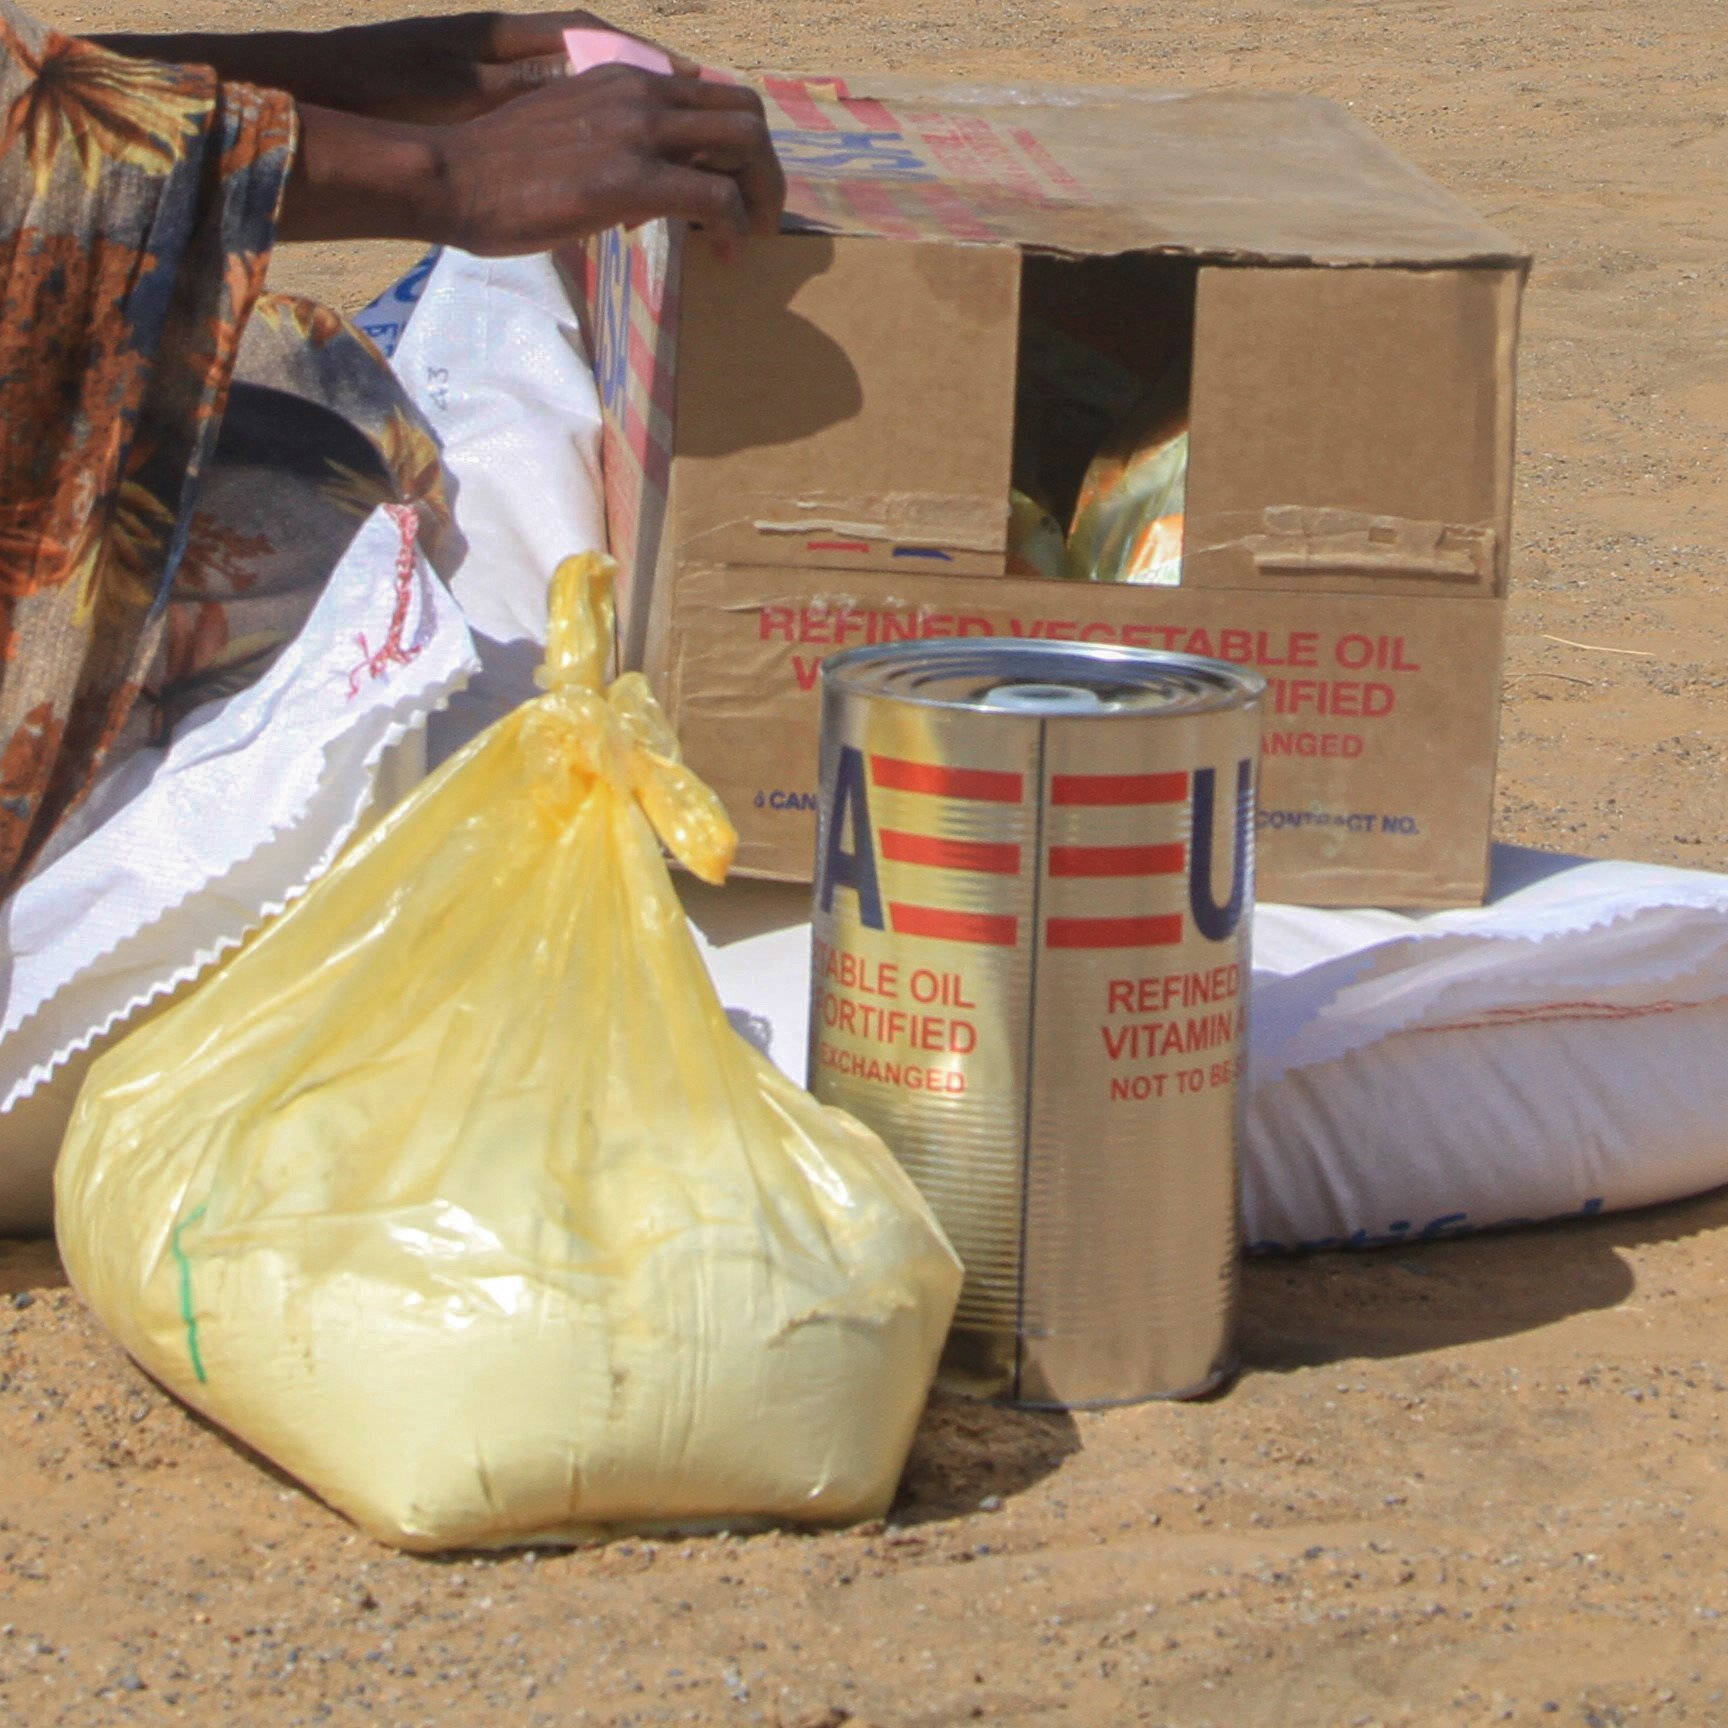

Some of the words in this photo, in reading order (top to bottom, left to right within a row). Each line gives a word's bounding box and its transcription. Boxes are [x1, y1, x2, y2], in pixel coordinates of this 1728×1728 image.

[758, 605, 994, 645] REFINED
[1009, 617, 1319, 668] VEGETABLE
[1334, 633, 1421, 672] OIL
[1267, 678, 1396, 718] IFIED
[1380, 814, 1422, 835] NO.
[815, 938, 899, 1000] TABLE
[910, 968, 977, 1010] OIL
[1107, 963, 1240, 1015] REFINED
[1102, 1014, 1233, 1061] VITAMIN
[1109, 1073, 1168, 1102] NOT
[1175, 1067, 1206, 1094] TO
[1209, 1058, 1233, 1089] BE
